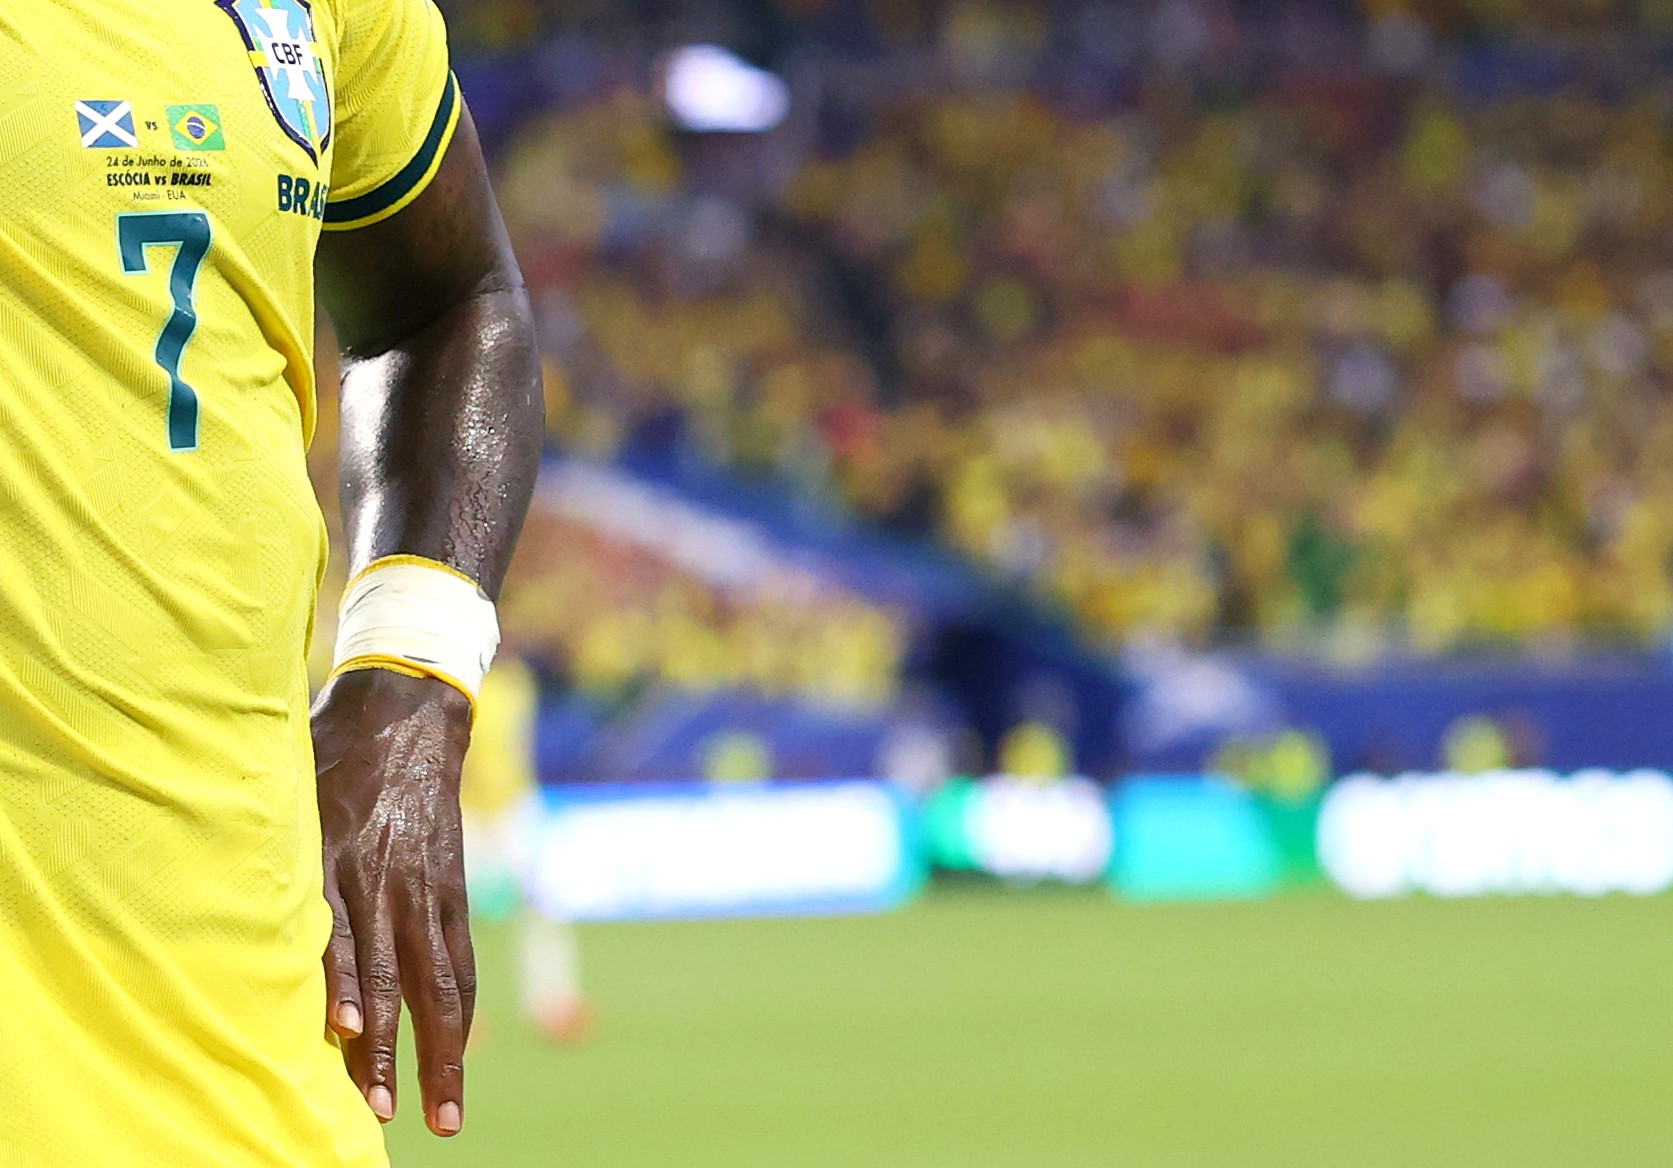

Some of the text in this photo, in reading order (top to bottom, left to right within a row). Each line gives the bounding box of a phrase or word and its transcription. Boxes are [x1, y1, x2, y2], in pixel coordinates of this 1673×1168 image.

[271, 42, 303, 66] CBF
[106, 156, 119, 167] 24
[122, 155, 134, 167] de
[136, 155, 166, 167] Junho
[170, 156, 183, 168] de
[107, 169, 211, 187] ESCÓCIA vs BRASIL
[167, 189, 186, 200] EUA
[116, 212, 211, 451] 7
